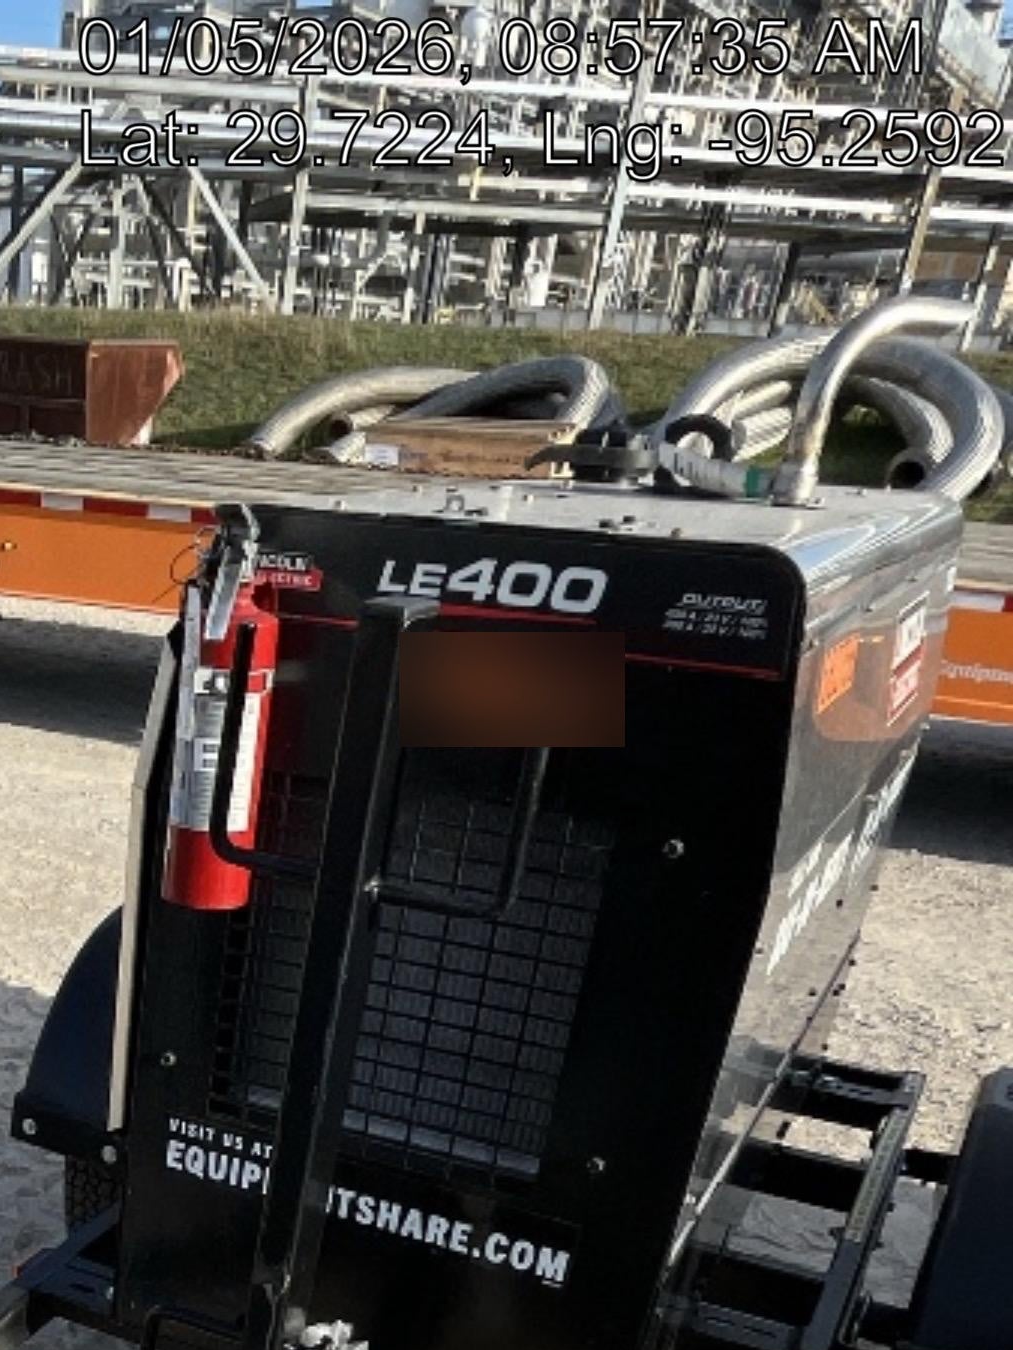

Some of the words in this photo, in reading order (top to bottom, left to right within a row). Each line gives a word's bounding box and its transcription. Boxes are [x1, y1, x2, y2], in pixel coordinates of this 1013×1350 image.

[378, 558, 607, 613] LE400
[168, 1117, 216, 1142] VISIT
[222, 1132, 244, 1151] US
[250, 1141, 274, 1159] AT
